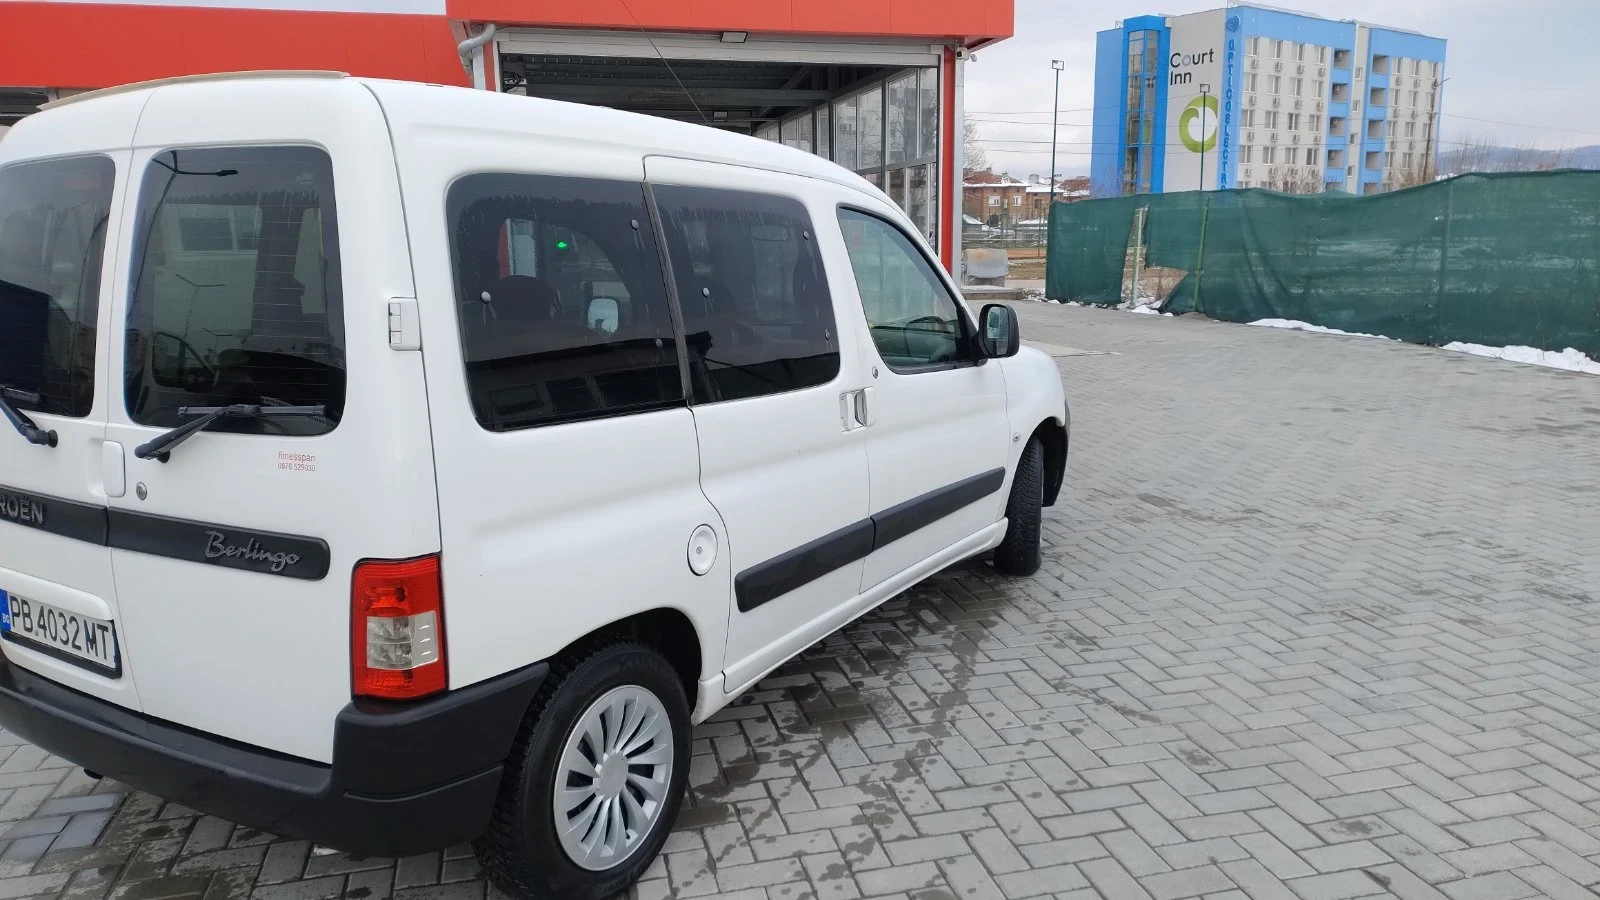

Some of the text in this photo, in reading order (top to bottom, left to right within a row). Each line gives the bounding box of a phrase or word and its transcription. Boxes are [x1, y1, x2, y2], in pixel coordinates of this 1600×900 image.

[1170, 48, 1214, 68] Court
[1169, 71, 1192, 85] Inn
[204, 530, 299, 572] Berlingo
